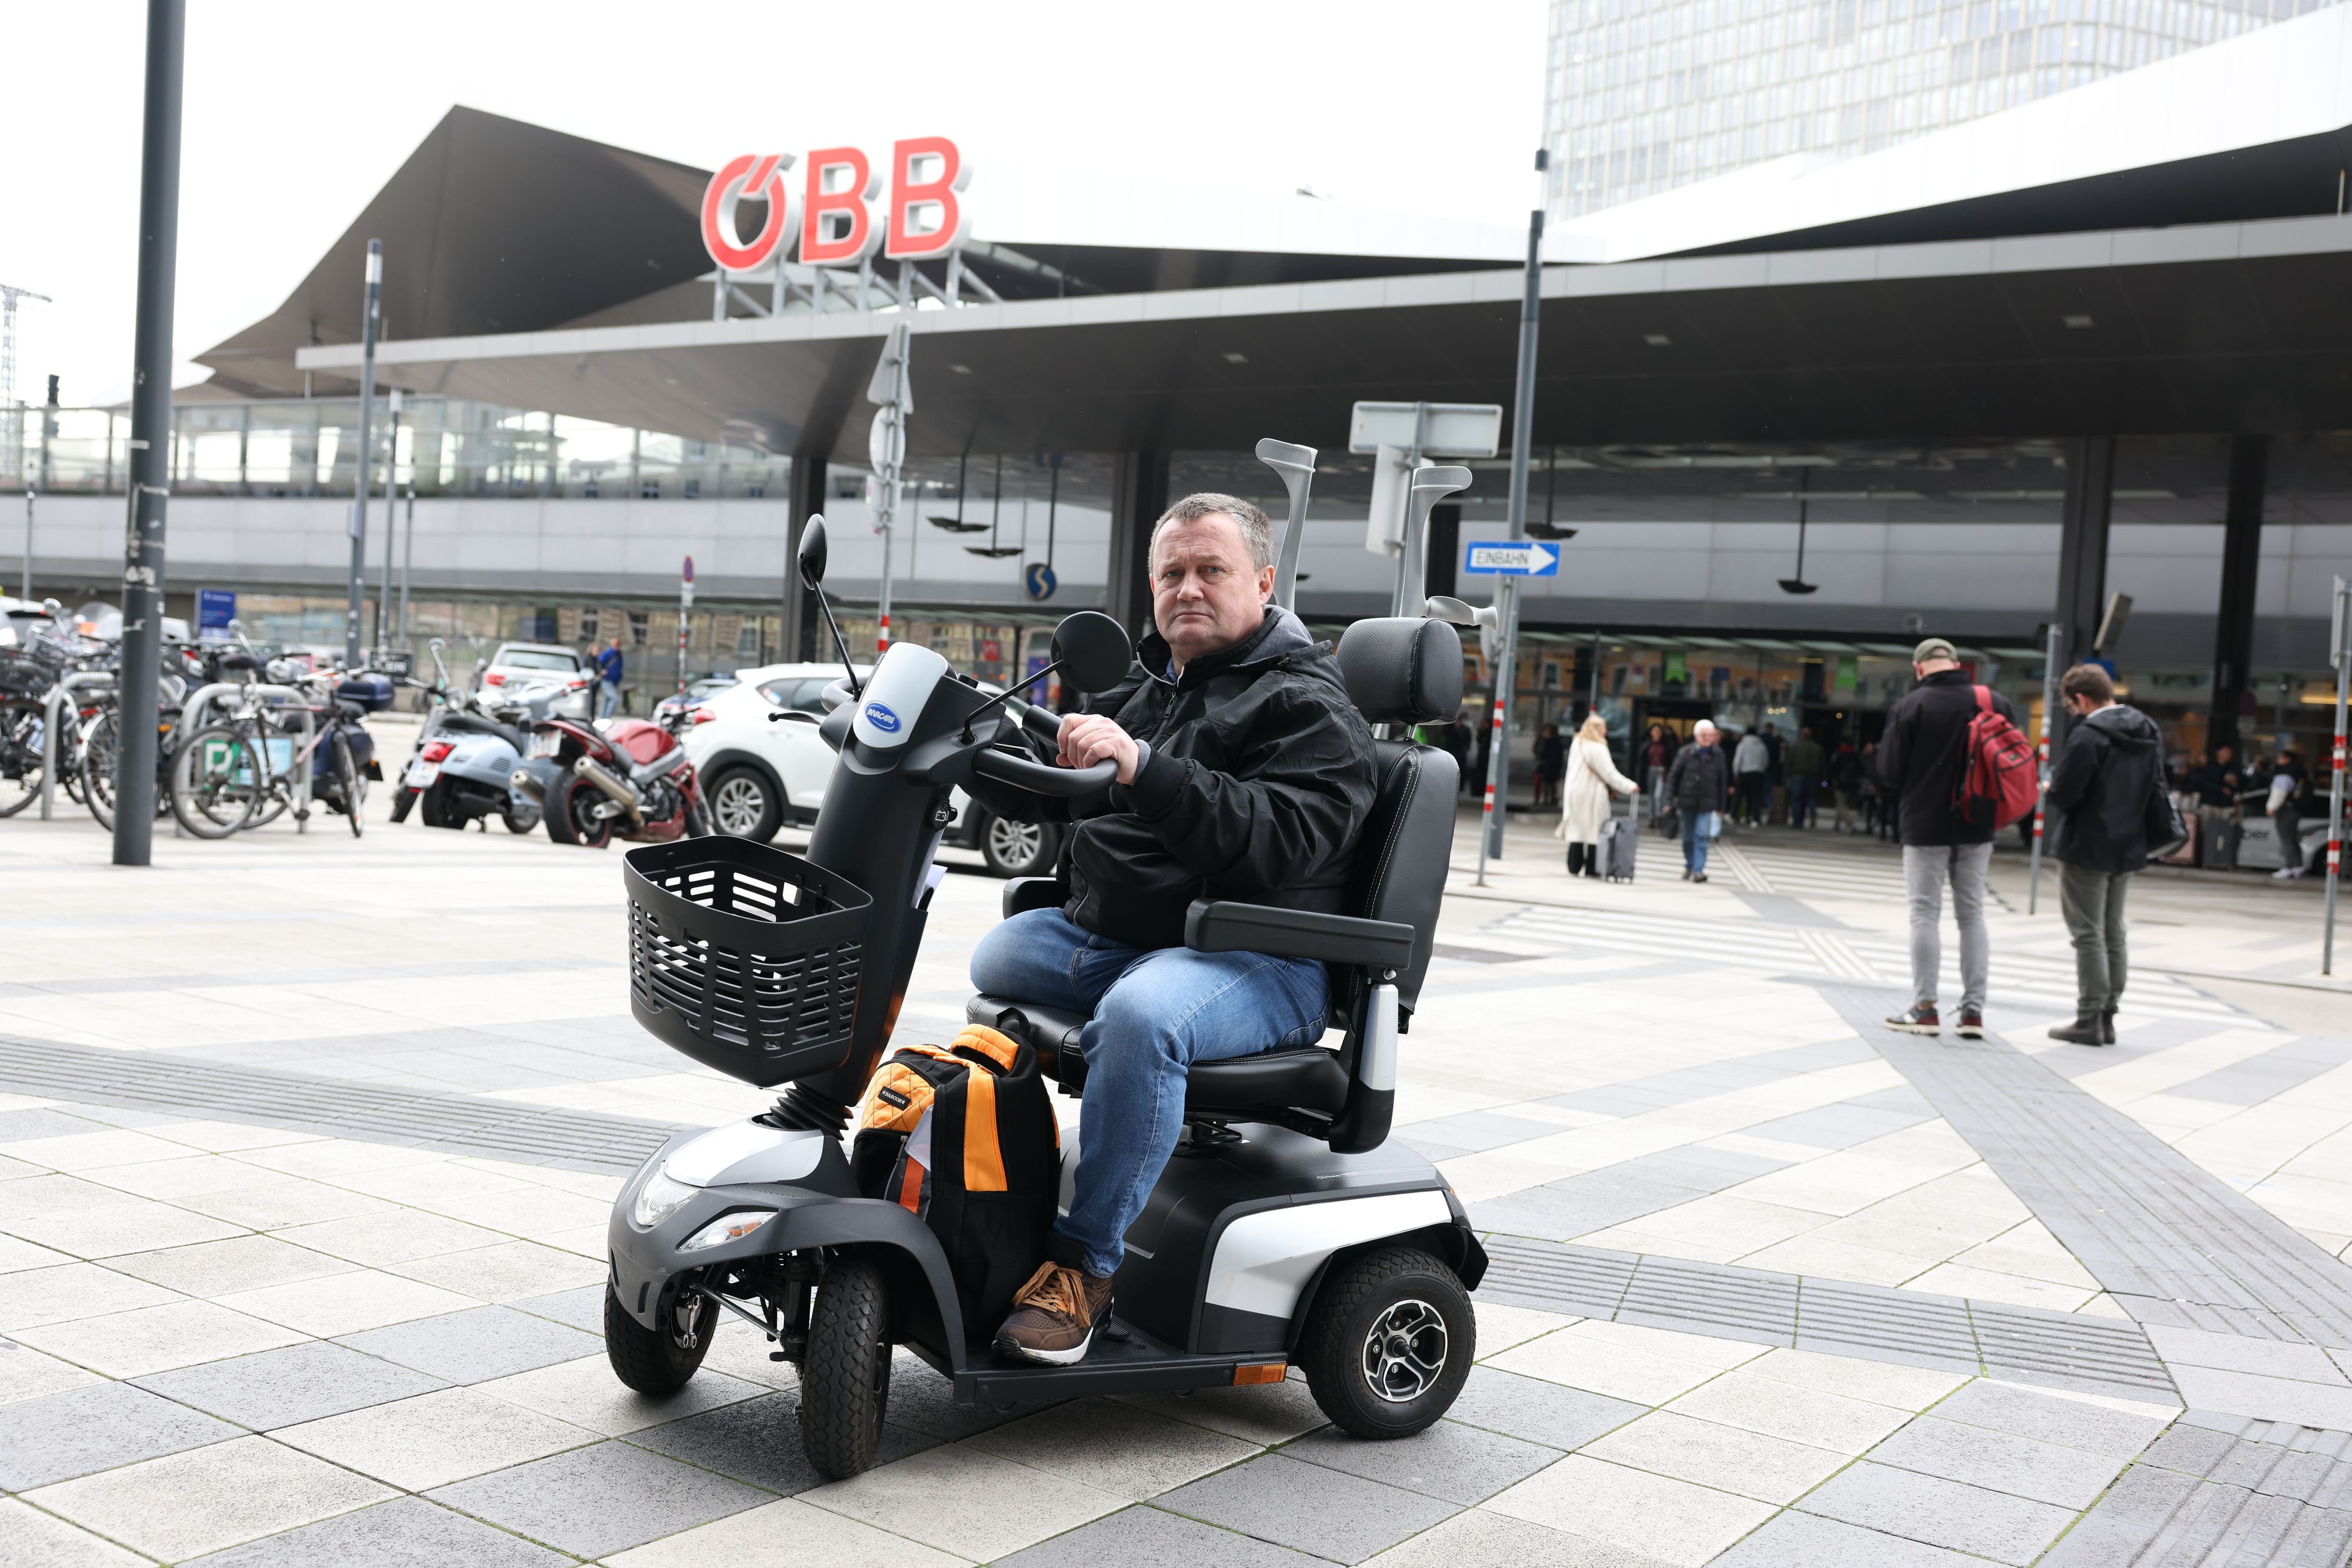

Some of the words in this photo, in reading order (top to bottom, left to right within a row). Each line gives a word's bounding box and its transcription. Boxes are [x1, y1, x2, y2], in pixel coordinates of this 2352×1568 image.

[701, 136, 961, 272] ÖBB
[1476, 550, 1528, 565] EINBAHN
[867, 708, 896, 724] INVACARE
[885, 1092, 902, 1104] BABOON
